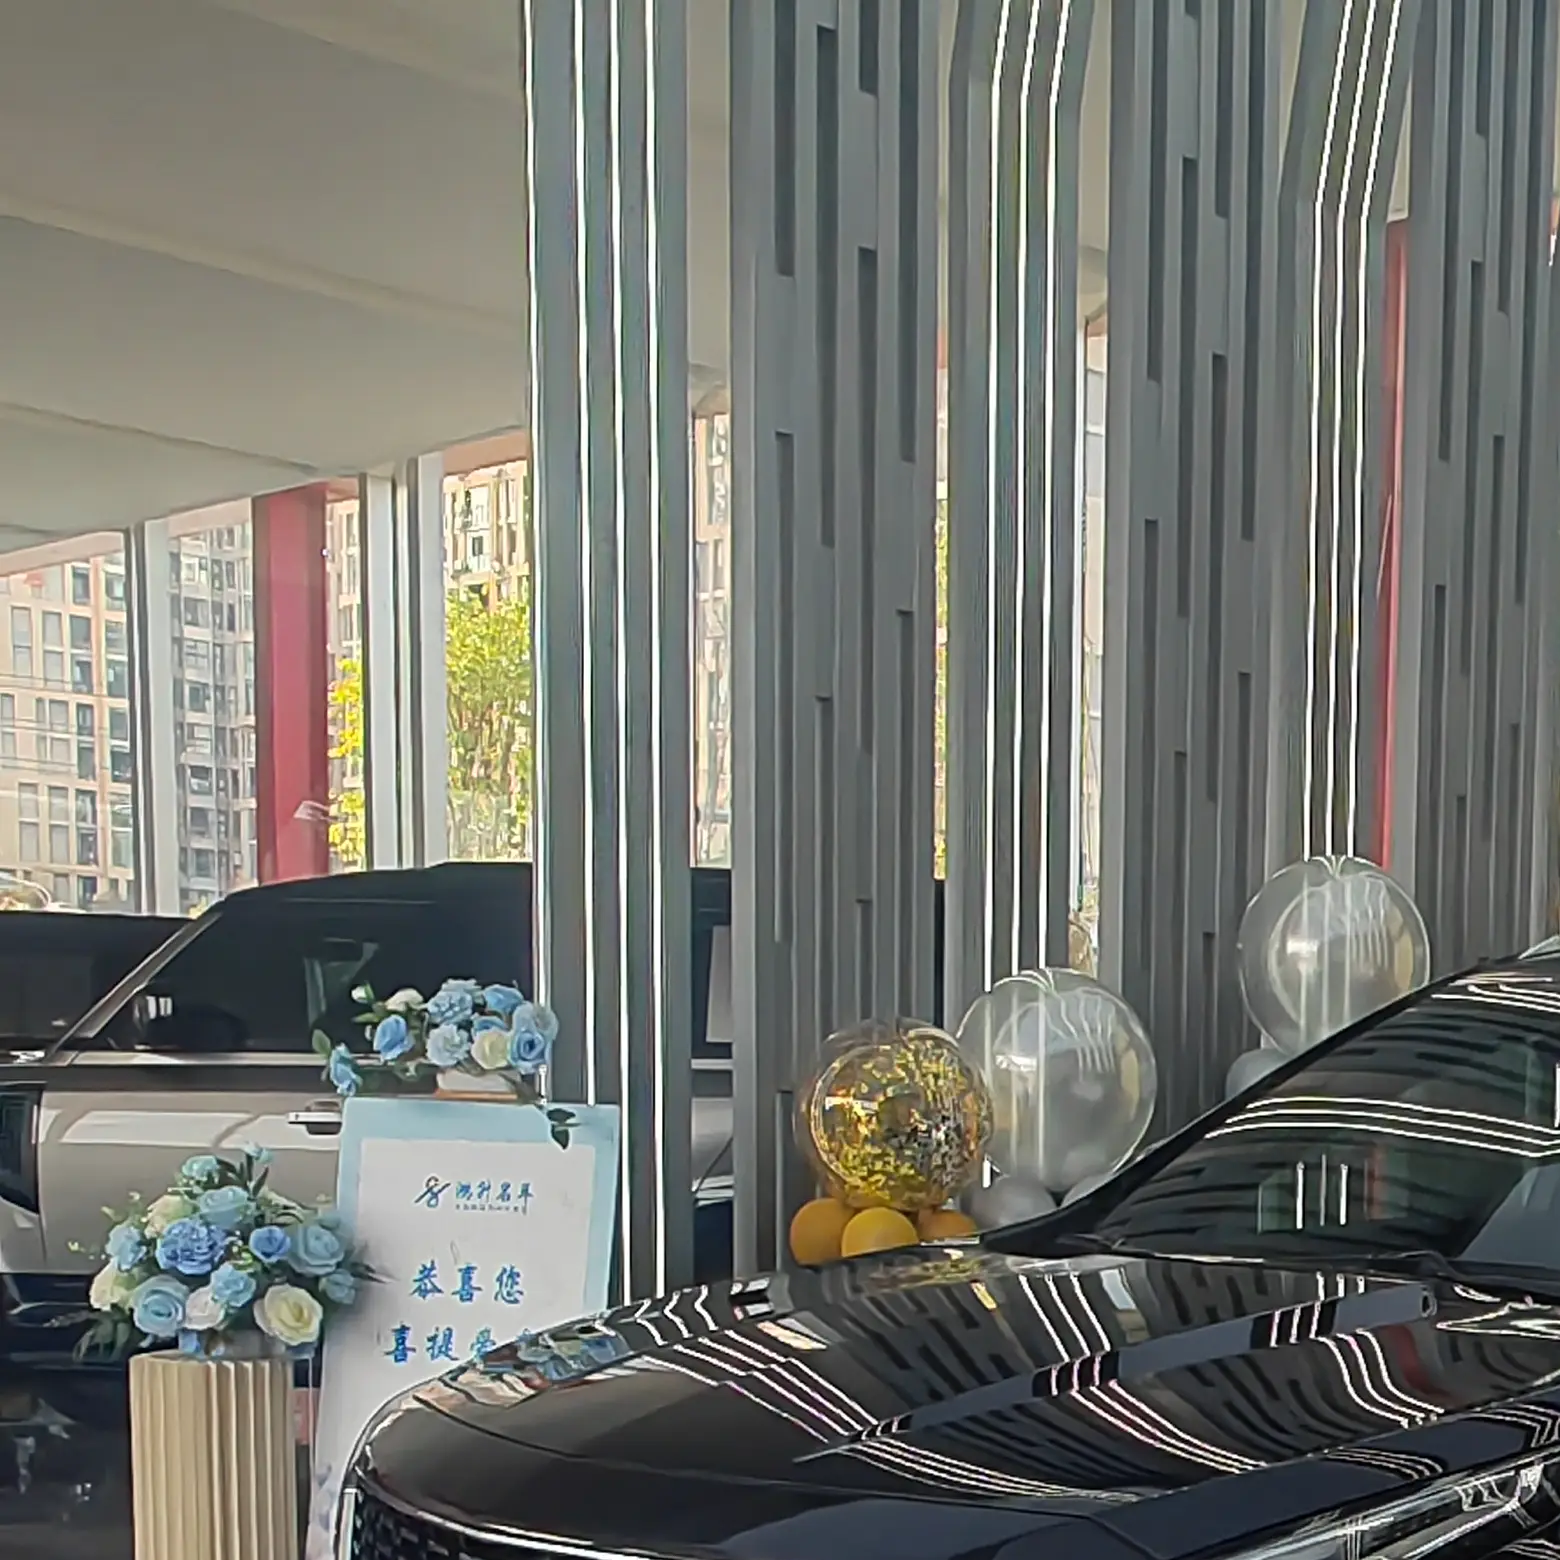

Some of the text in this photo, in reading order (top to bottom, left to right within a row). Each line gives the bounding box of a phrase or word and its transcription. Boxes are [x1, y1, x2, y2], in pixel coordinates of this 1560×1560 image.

[410, 1259, 524, 1304] 恭喜您
[384, 1322, 532, 1363] 喜提爱
